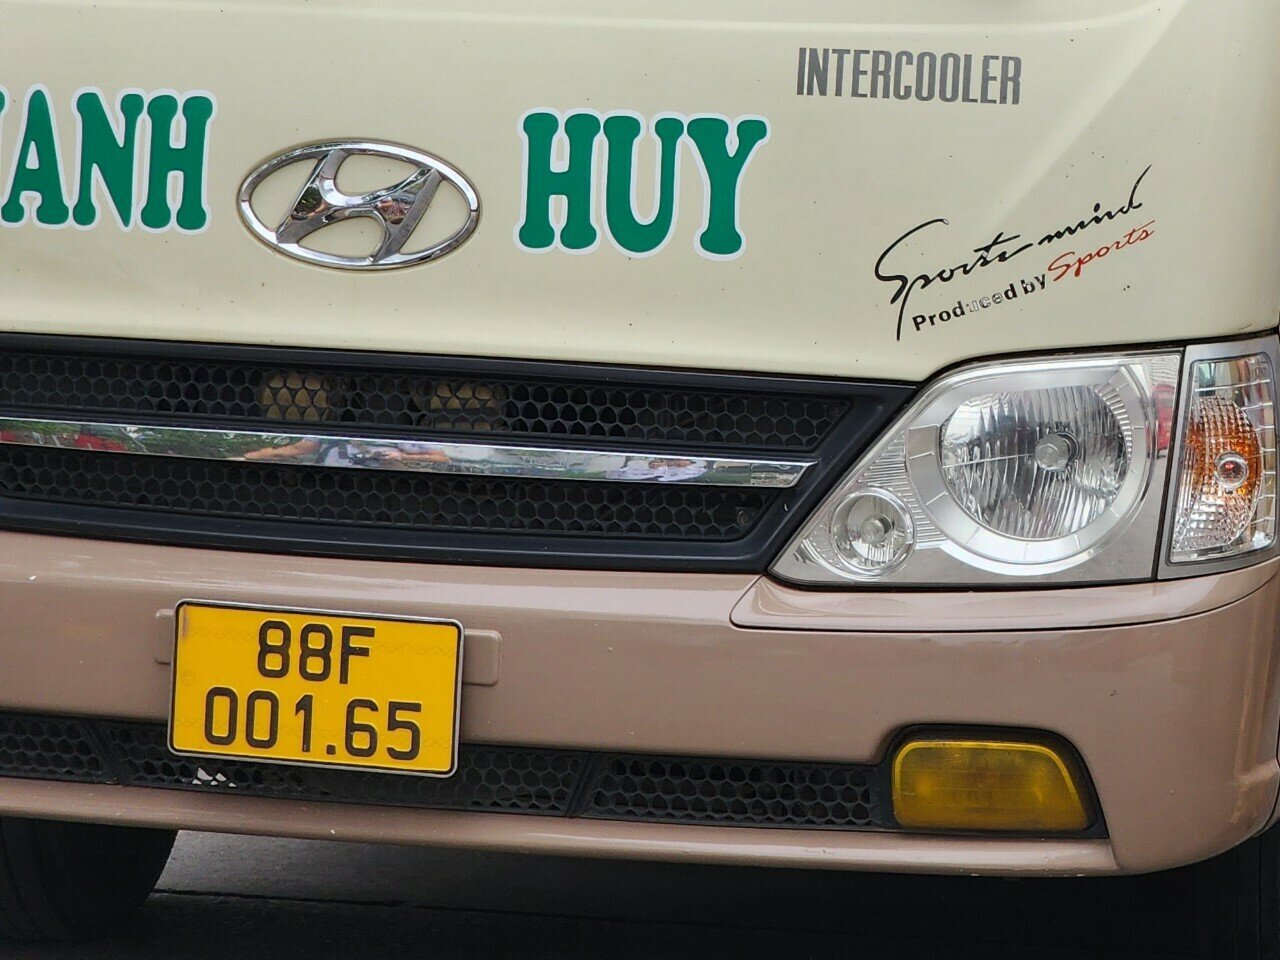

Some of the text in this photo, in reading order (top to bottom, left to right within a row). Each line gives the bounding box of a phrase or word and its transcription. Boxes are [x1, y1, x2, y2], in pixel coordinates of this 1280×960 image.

[796, 47, 1023, 105] INTERCOOLER
[0, 86, 215, 232] ANH
[519, 111, 768, 256] HUY
[911, 219, 1156, 332] Produced by Sports
[256, 620, 376, 686] 88F
[203, 686, 423, 761] 001.65
